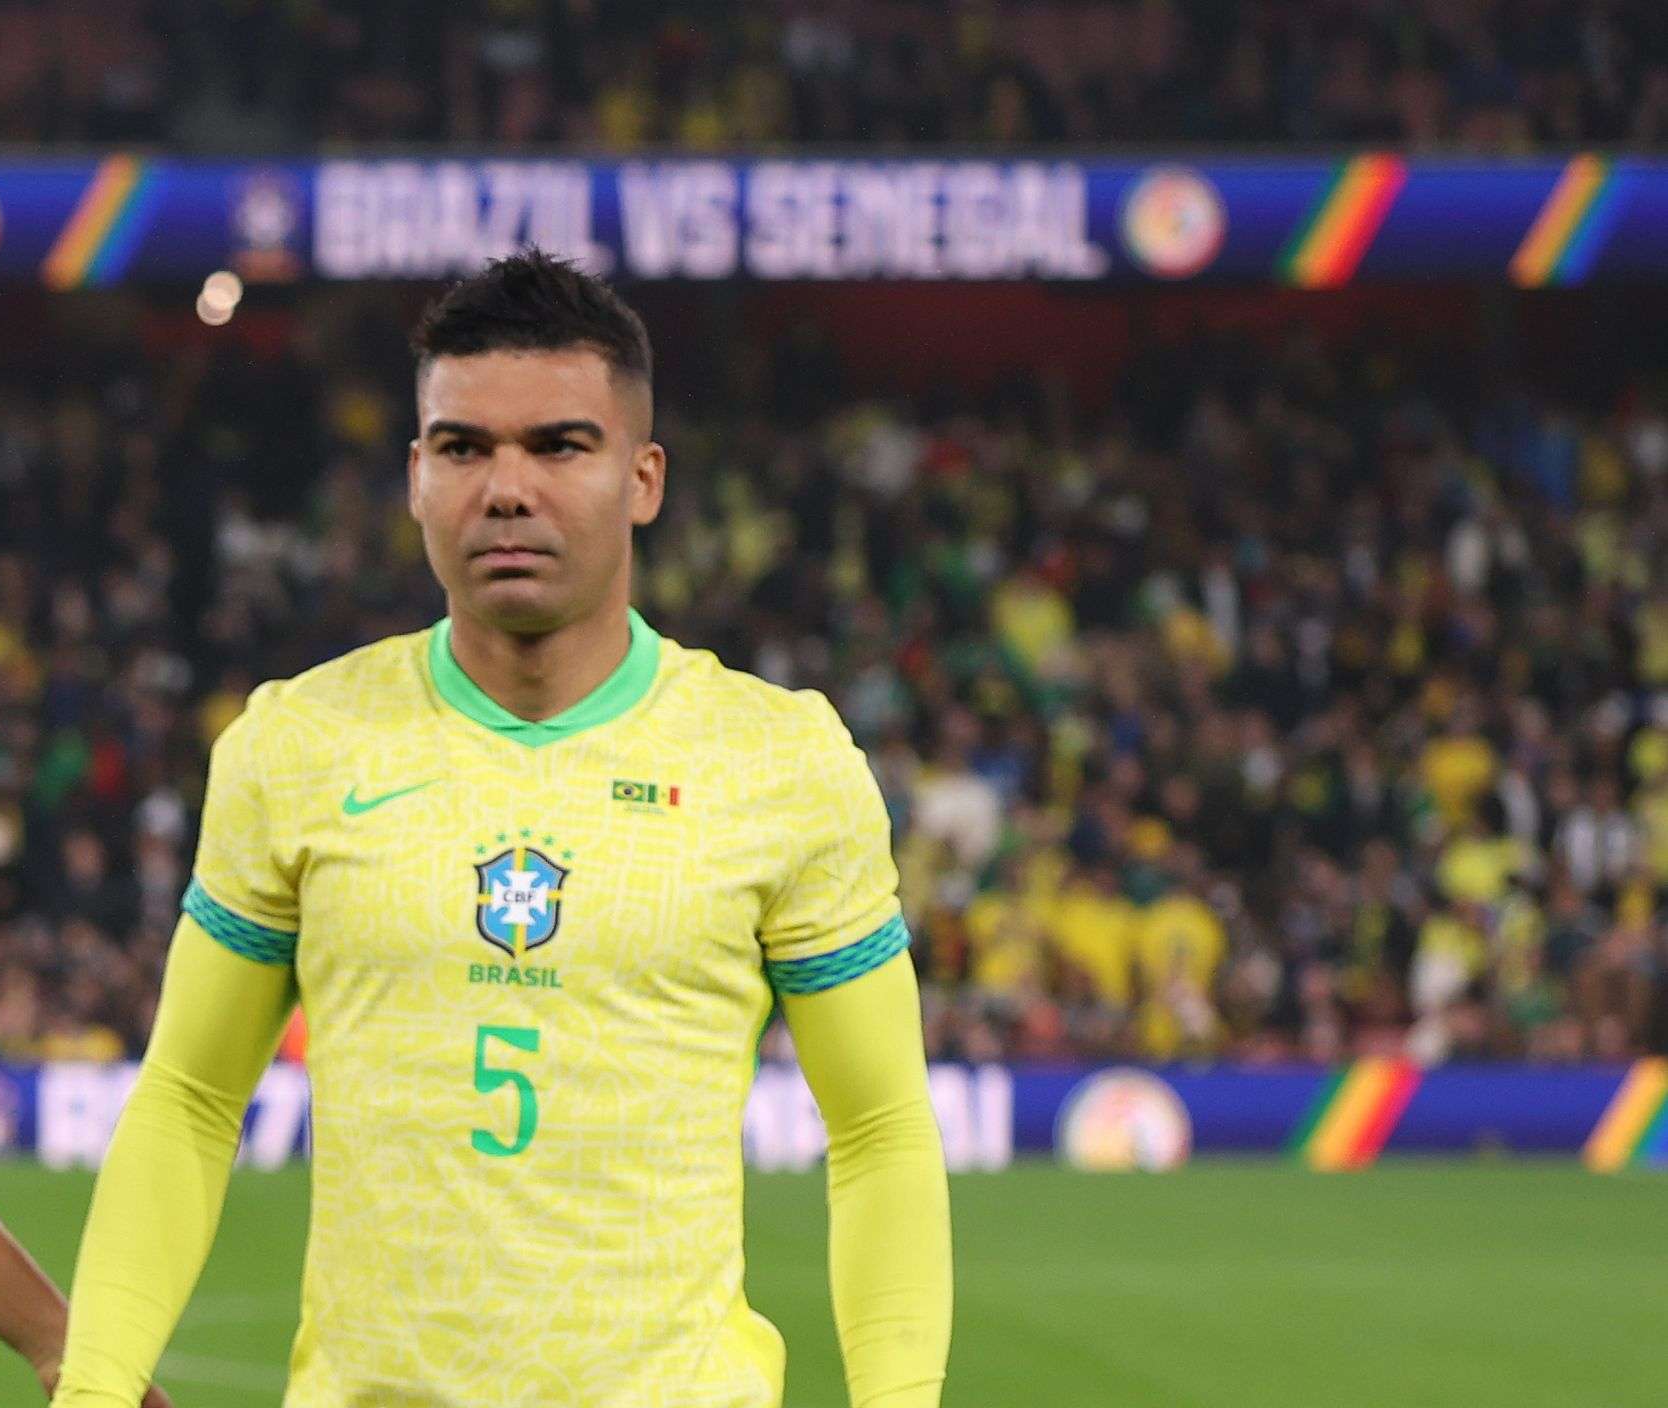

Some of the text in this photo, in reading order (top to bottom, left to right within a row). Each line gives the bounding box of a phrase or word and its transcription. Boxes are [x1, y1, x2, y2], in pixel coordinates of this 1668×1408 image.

[617, 160, 737, 280] VS
[746, 160, 1108, 280] SENEGAL
[469, 964, 563, 988] BRASIL
[470, 1025, 541, 1158] 5
